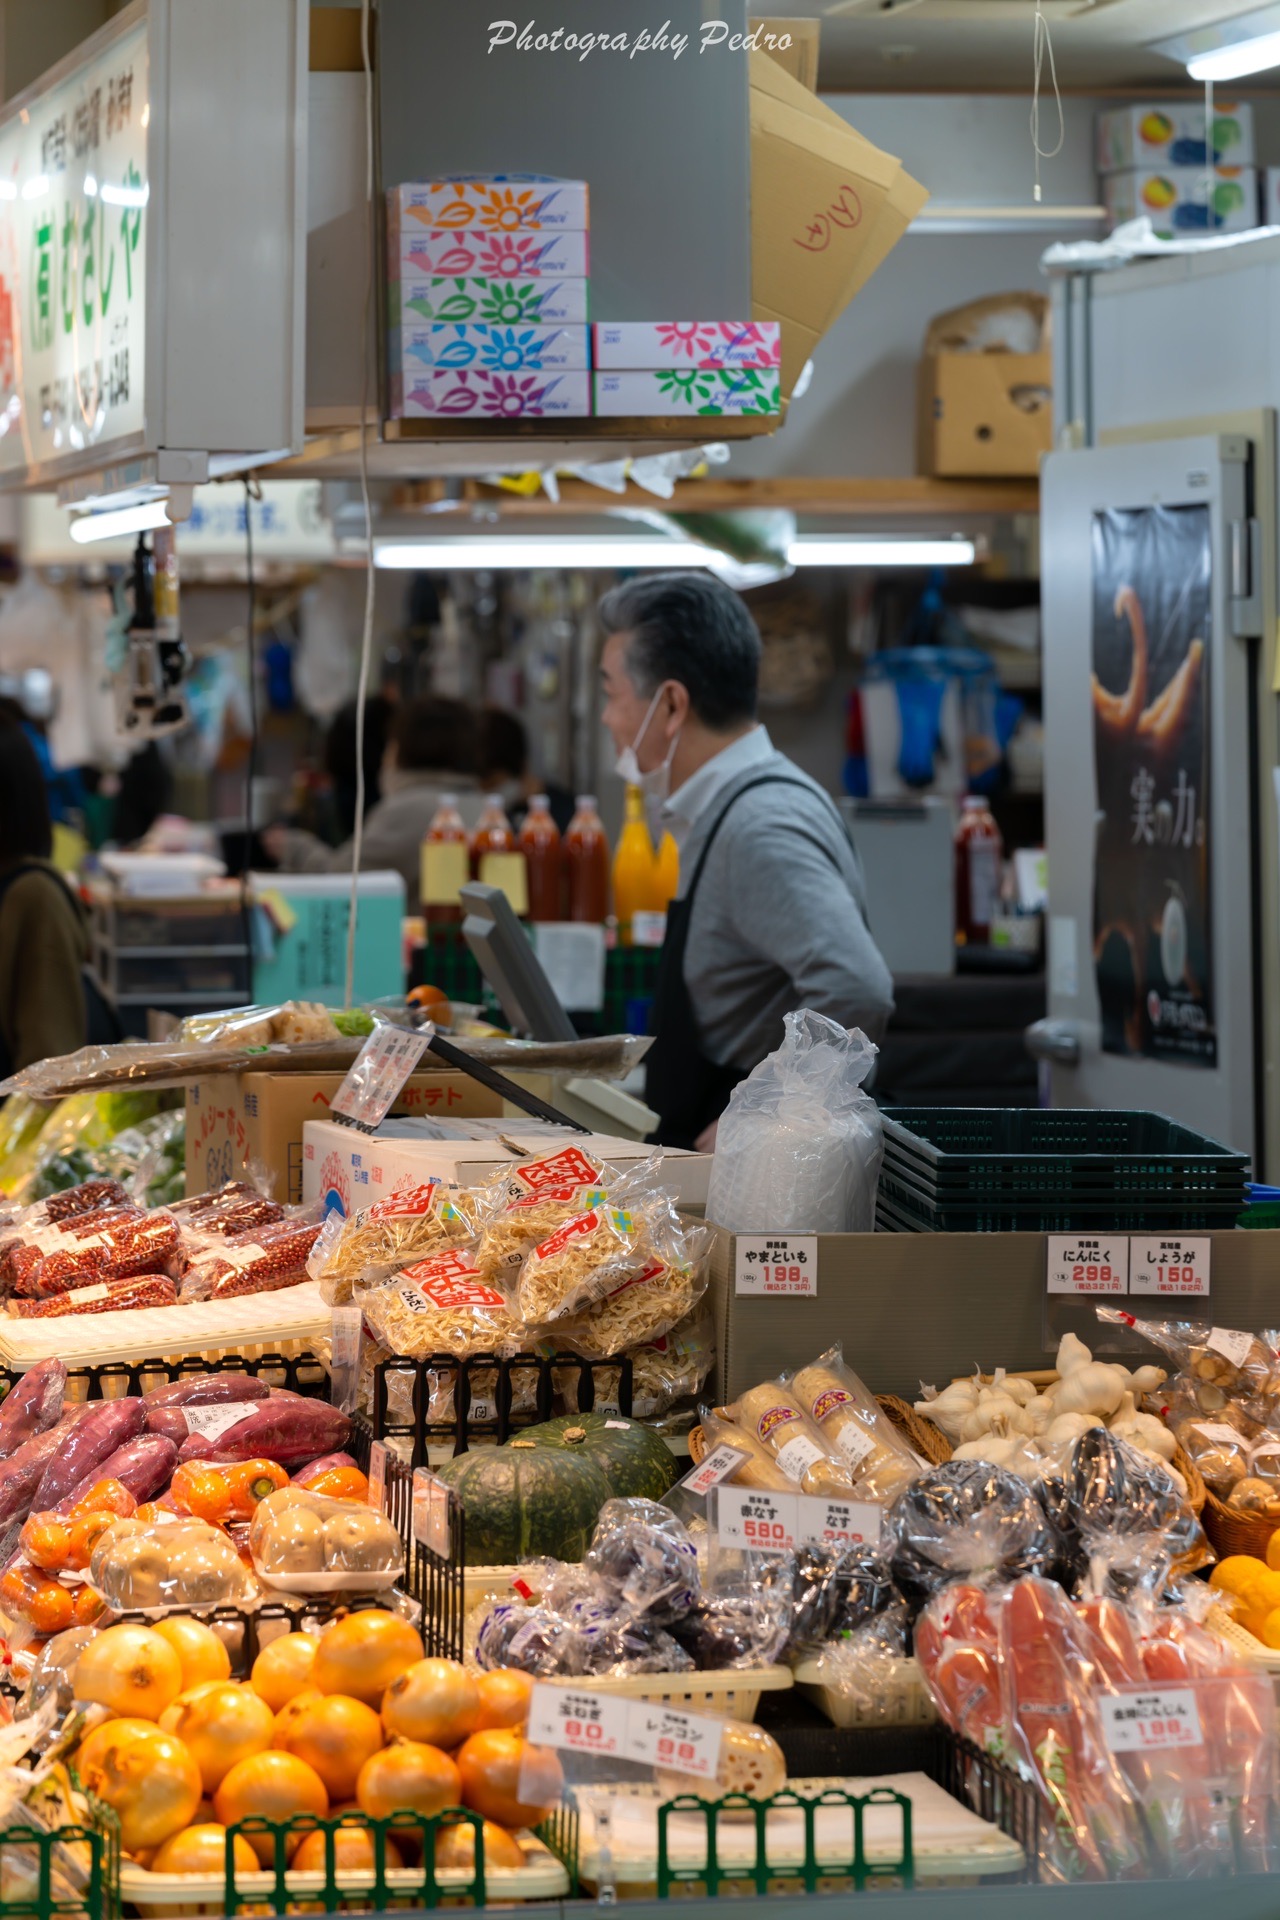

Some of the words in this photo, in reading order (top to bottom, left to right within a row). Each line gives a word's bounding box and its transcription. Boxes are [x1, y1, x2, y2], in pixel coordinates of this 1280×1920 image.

[745, 1250, 808, 1264] やまといも
[1063, 1250, 1111, 1263] にんにく
[1147, 1251, 1195, 1264] しょうが
[741, 1504, 778, 1520] 赤なす
[826, 1514, 851, 1529] なす
[646, 1718, 703, 1742] レンコン
